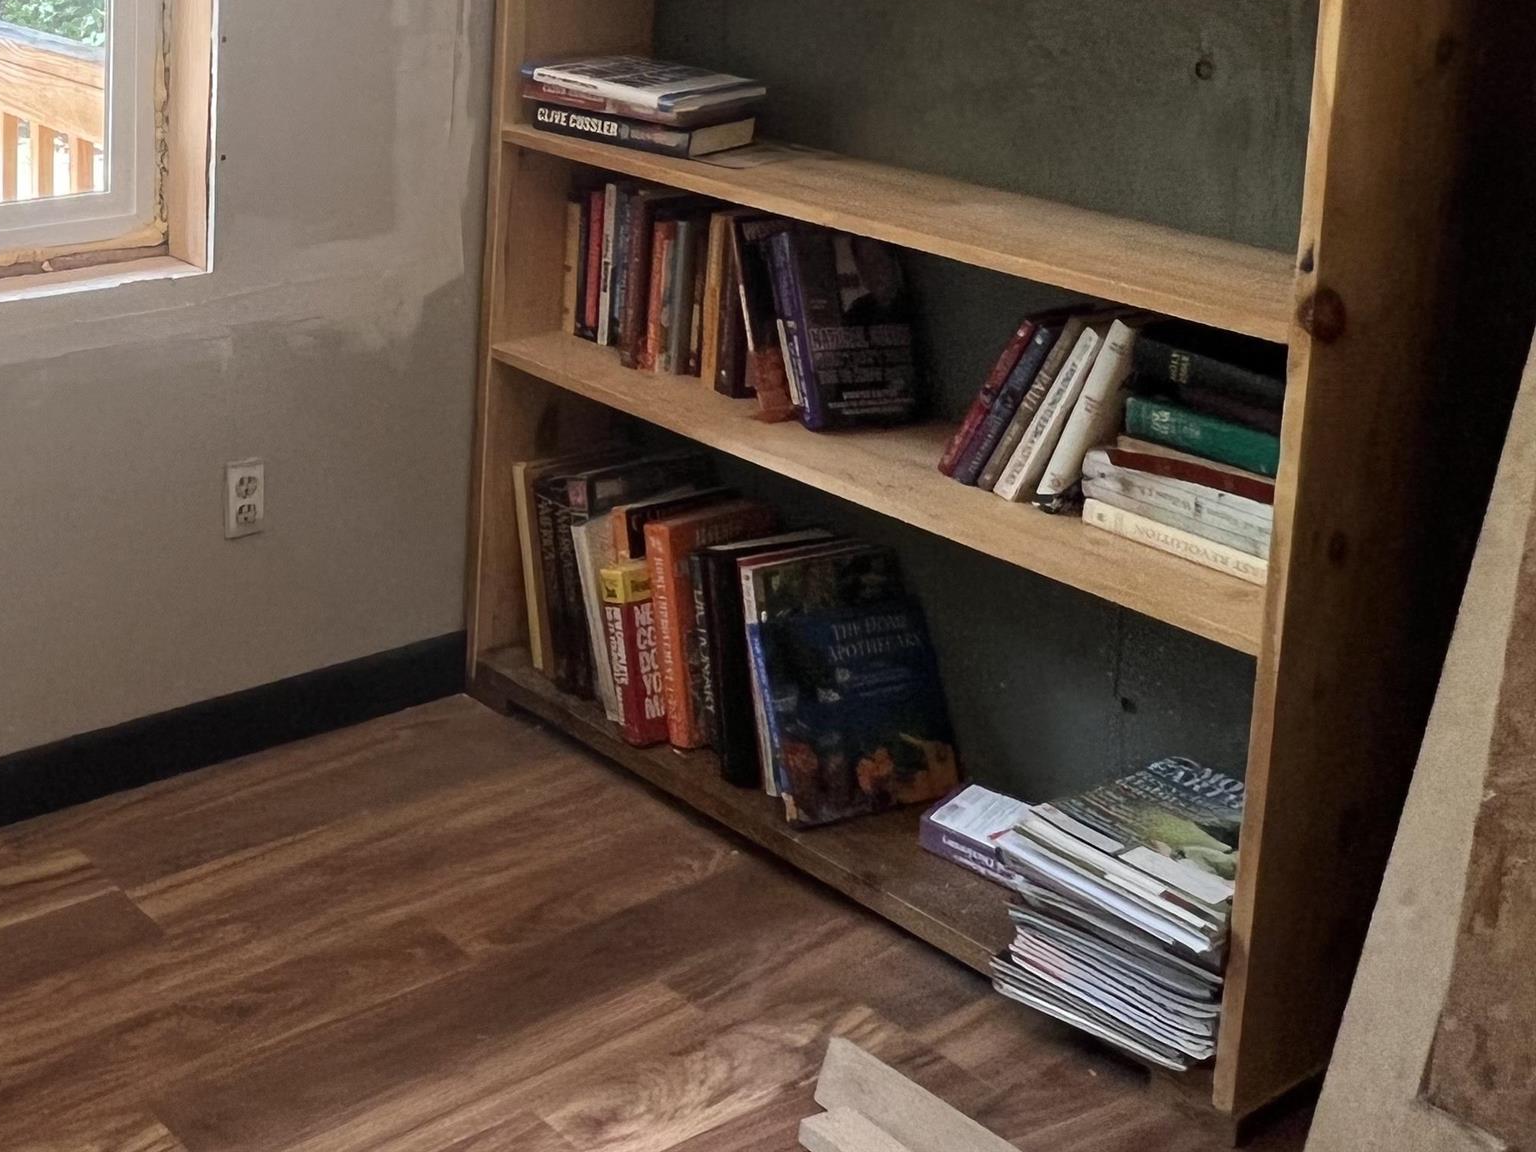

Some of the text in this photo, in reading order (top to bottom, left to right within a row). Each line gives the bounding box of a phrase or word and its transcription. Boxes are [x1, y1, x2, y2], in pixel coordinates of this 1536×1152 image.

[537, 107, 619, 136] CLIVE CUSSLER
[1132, 522, 1229, 567] REVOLUTION
